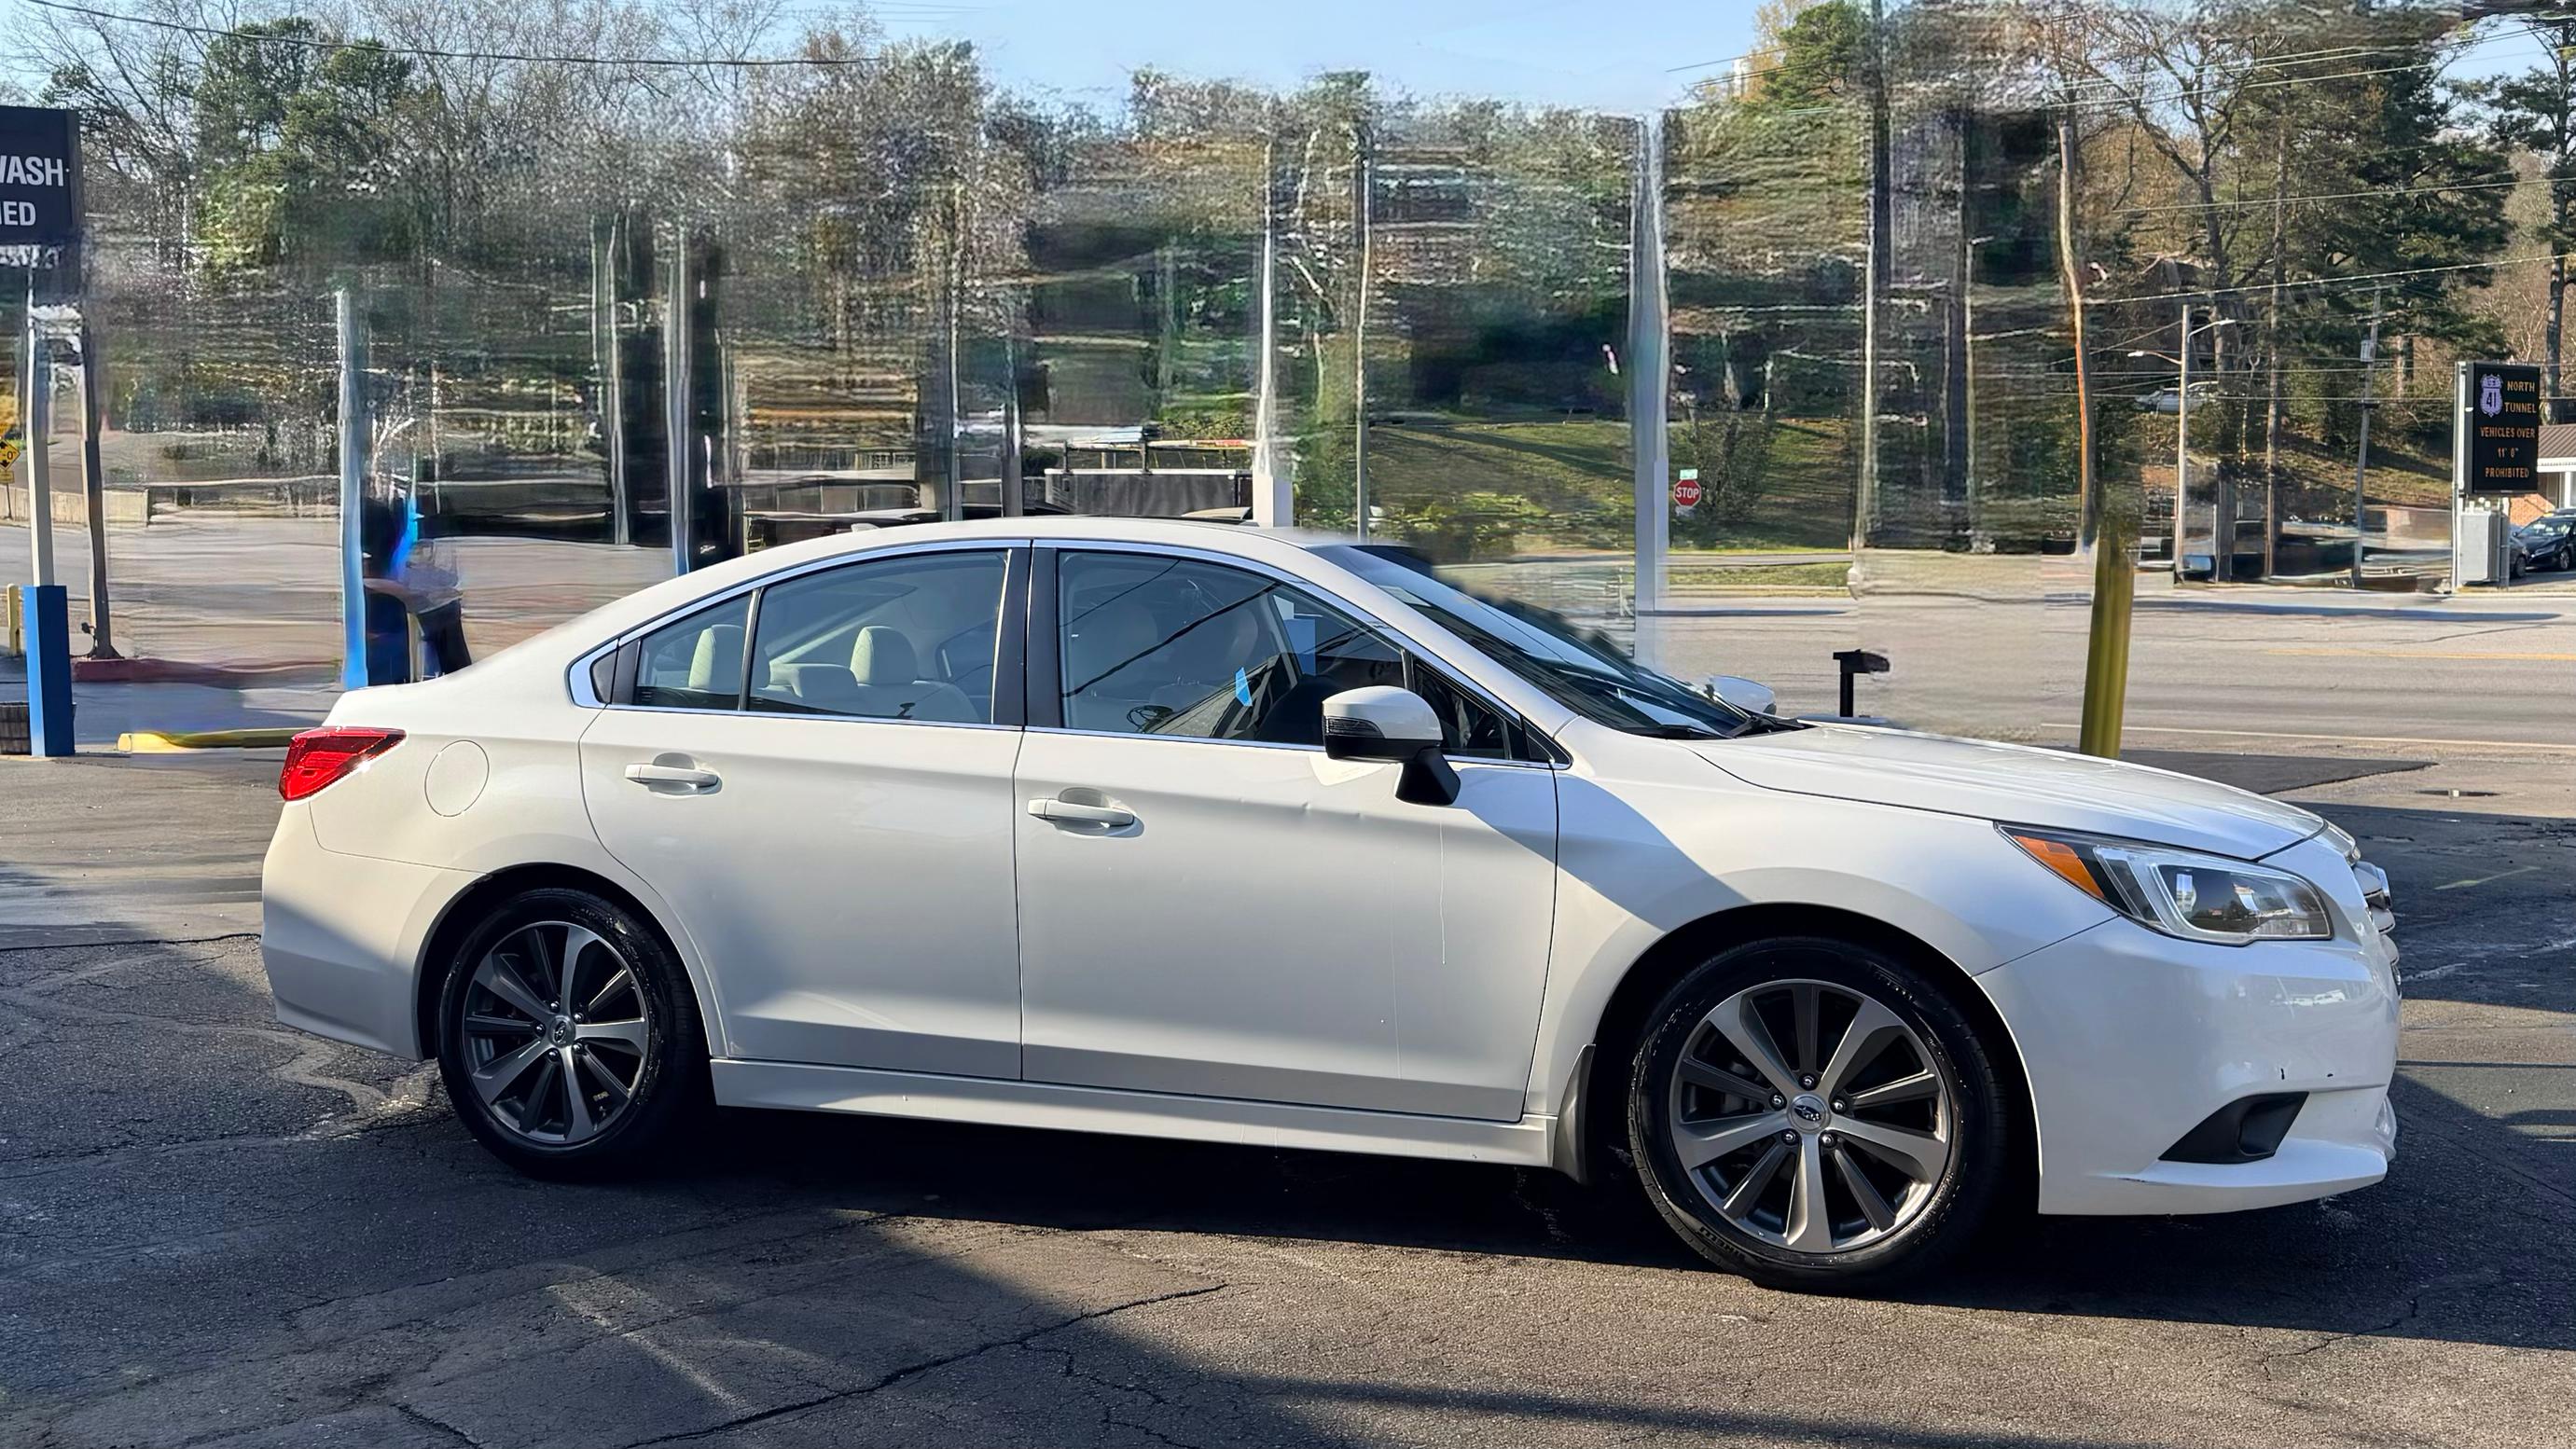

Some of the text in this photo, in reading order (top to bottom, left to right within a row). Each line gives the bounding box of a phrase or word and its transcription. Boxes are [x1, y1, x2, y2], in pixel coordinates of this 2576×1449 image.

[0, 200, 36, 226] ED
[2507, 380, 2535, 392] NORTH
[2486, 392, 2497, 408] 41
[2504, 402, 2537, 413] TUNNEL
[2480, 426, 2536, 438] VEHICLES OVER
[2485, 467, 2529, 478] PROHIBITED
[1676, 487, 1699, 499] STOP
